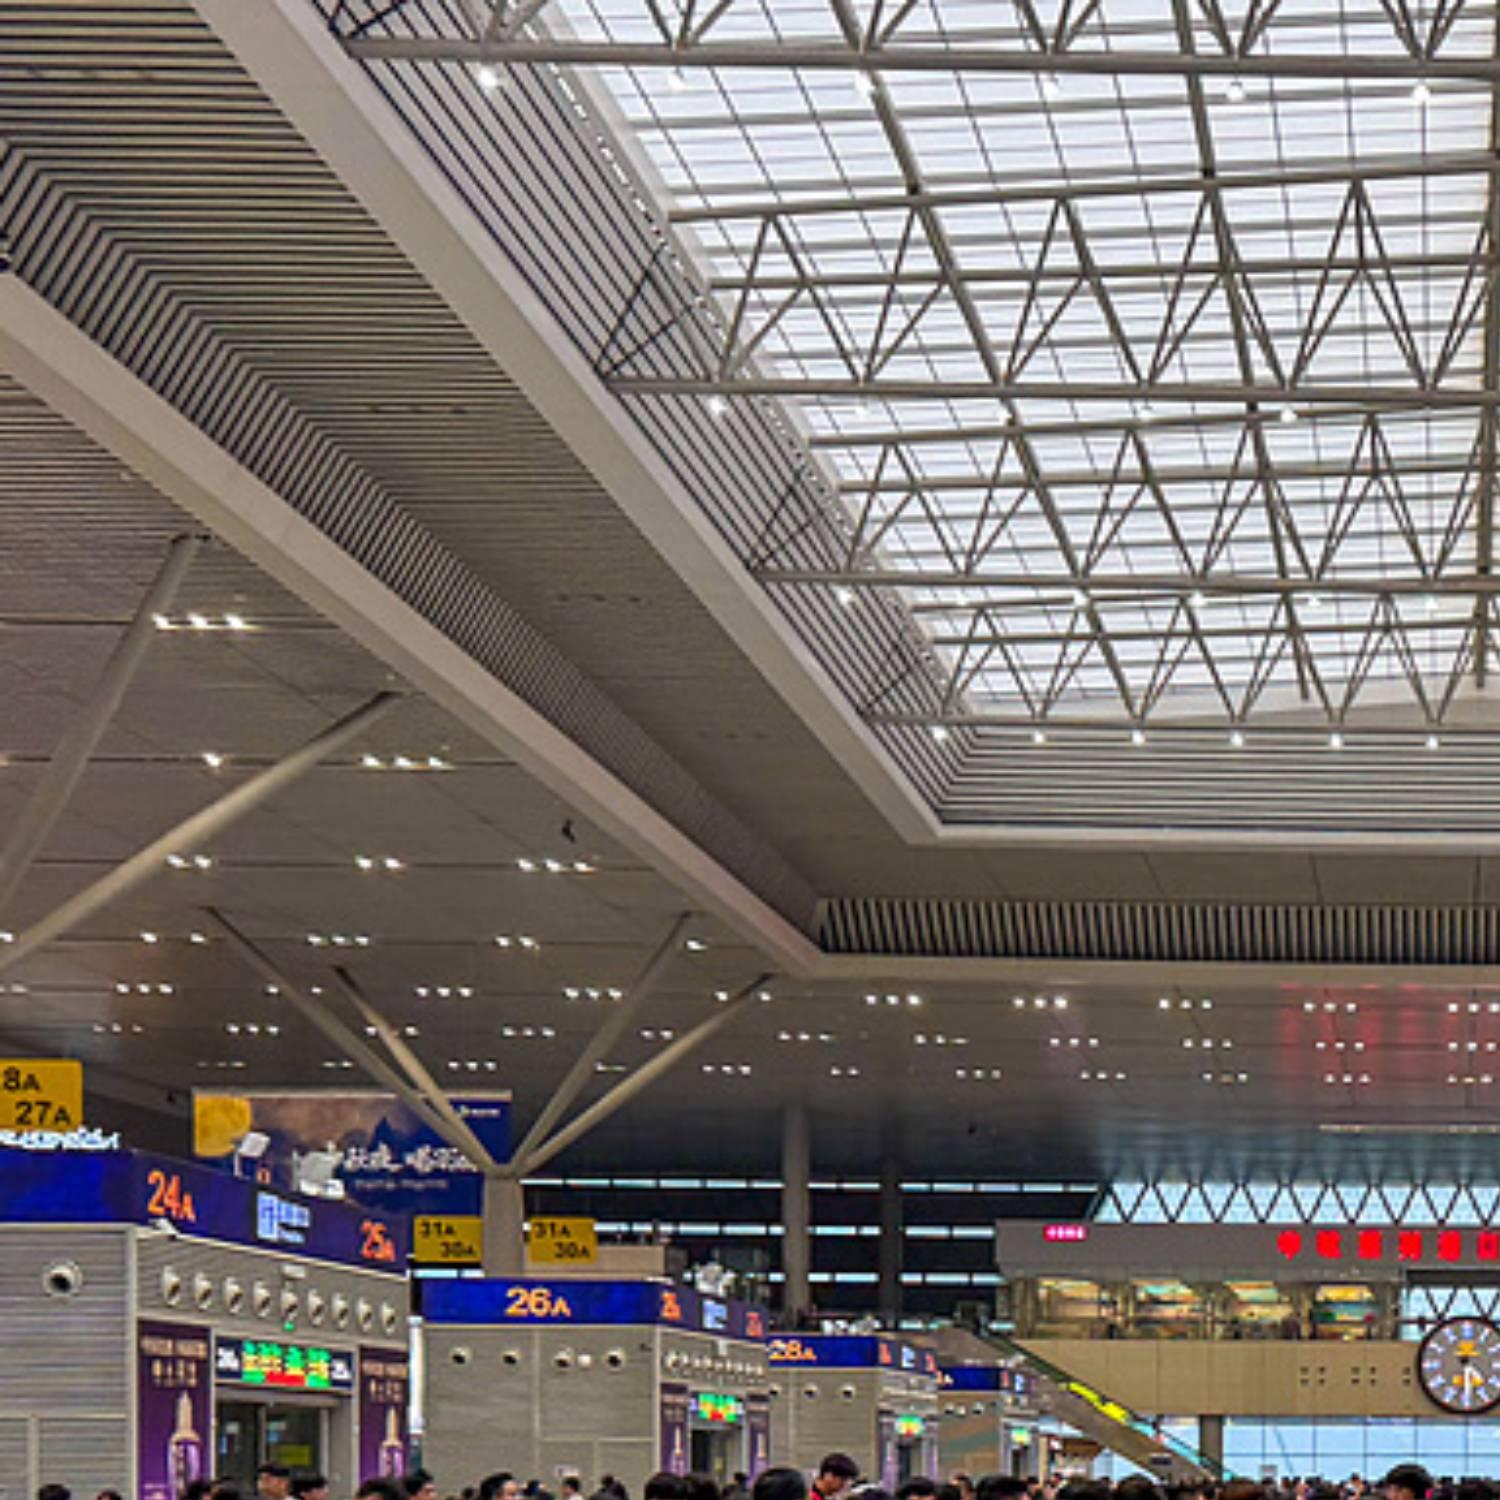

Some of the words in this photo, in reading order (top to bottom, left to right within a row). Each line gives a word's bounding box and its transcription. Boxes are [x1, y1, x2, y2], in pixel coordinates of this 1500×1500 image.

[15, 1101, 71, 1125] 27A
[147, 1169, 196, 1222] 24A
[420, 1222, 456, 1238] 31A
[534, 1222, 571, 1238] 31A
[505, 1286, 572, 1317] 26A
